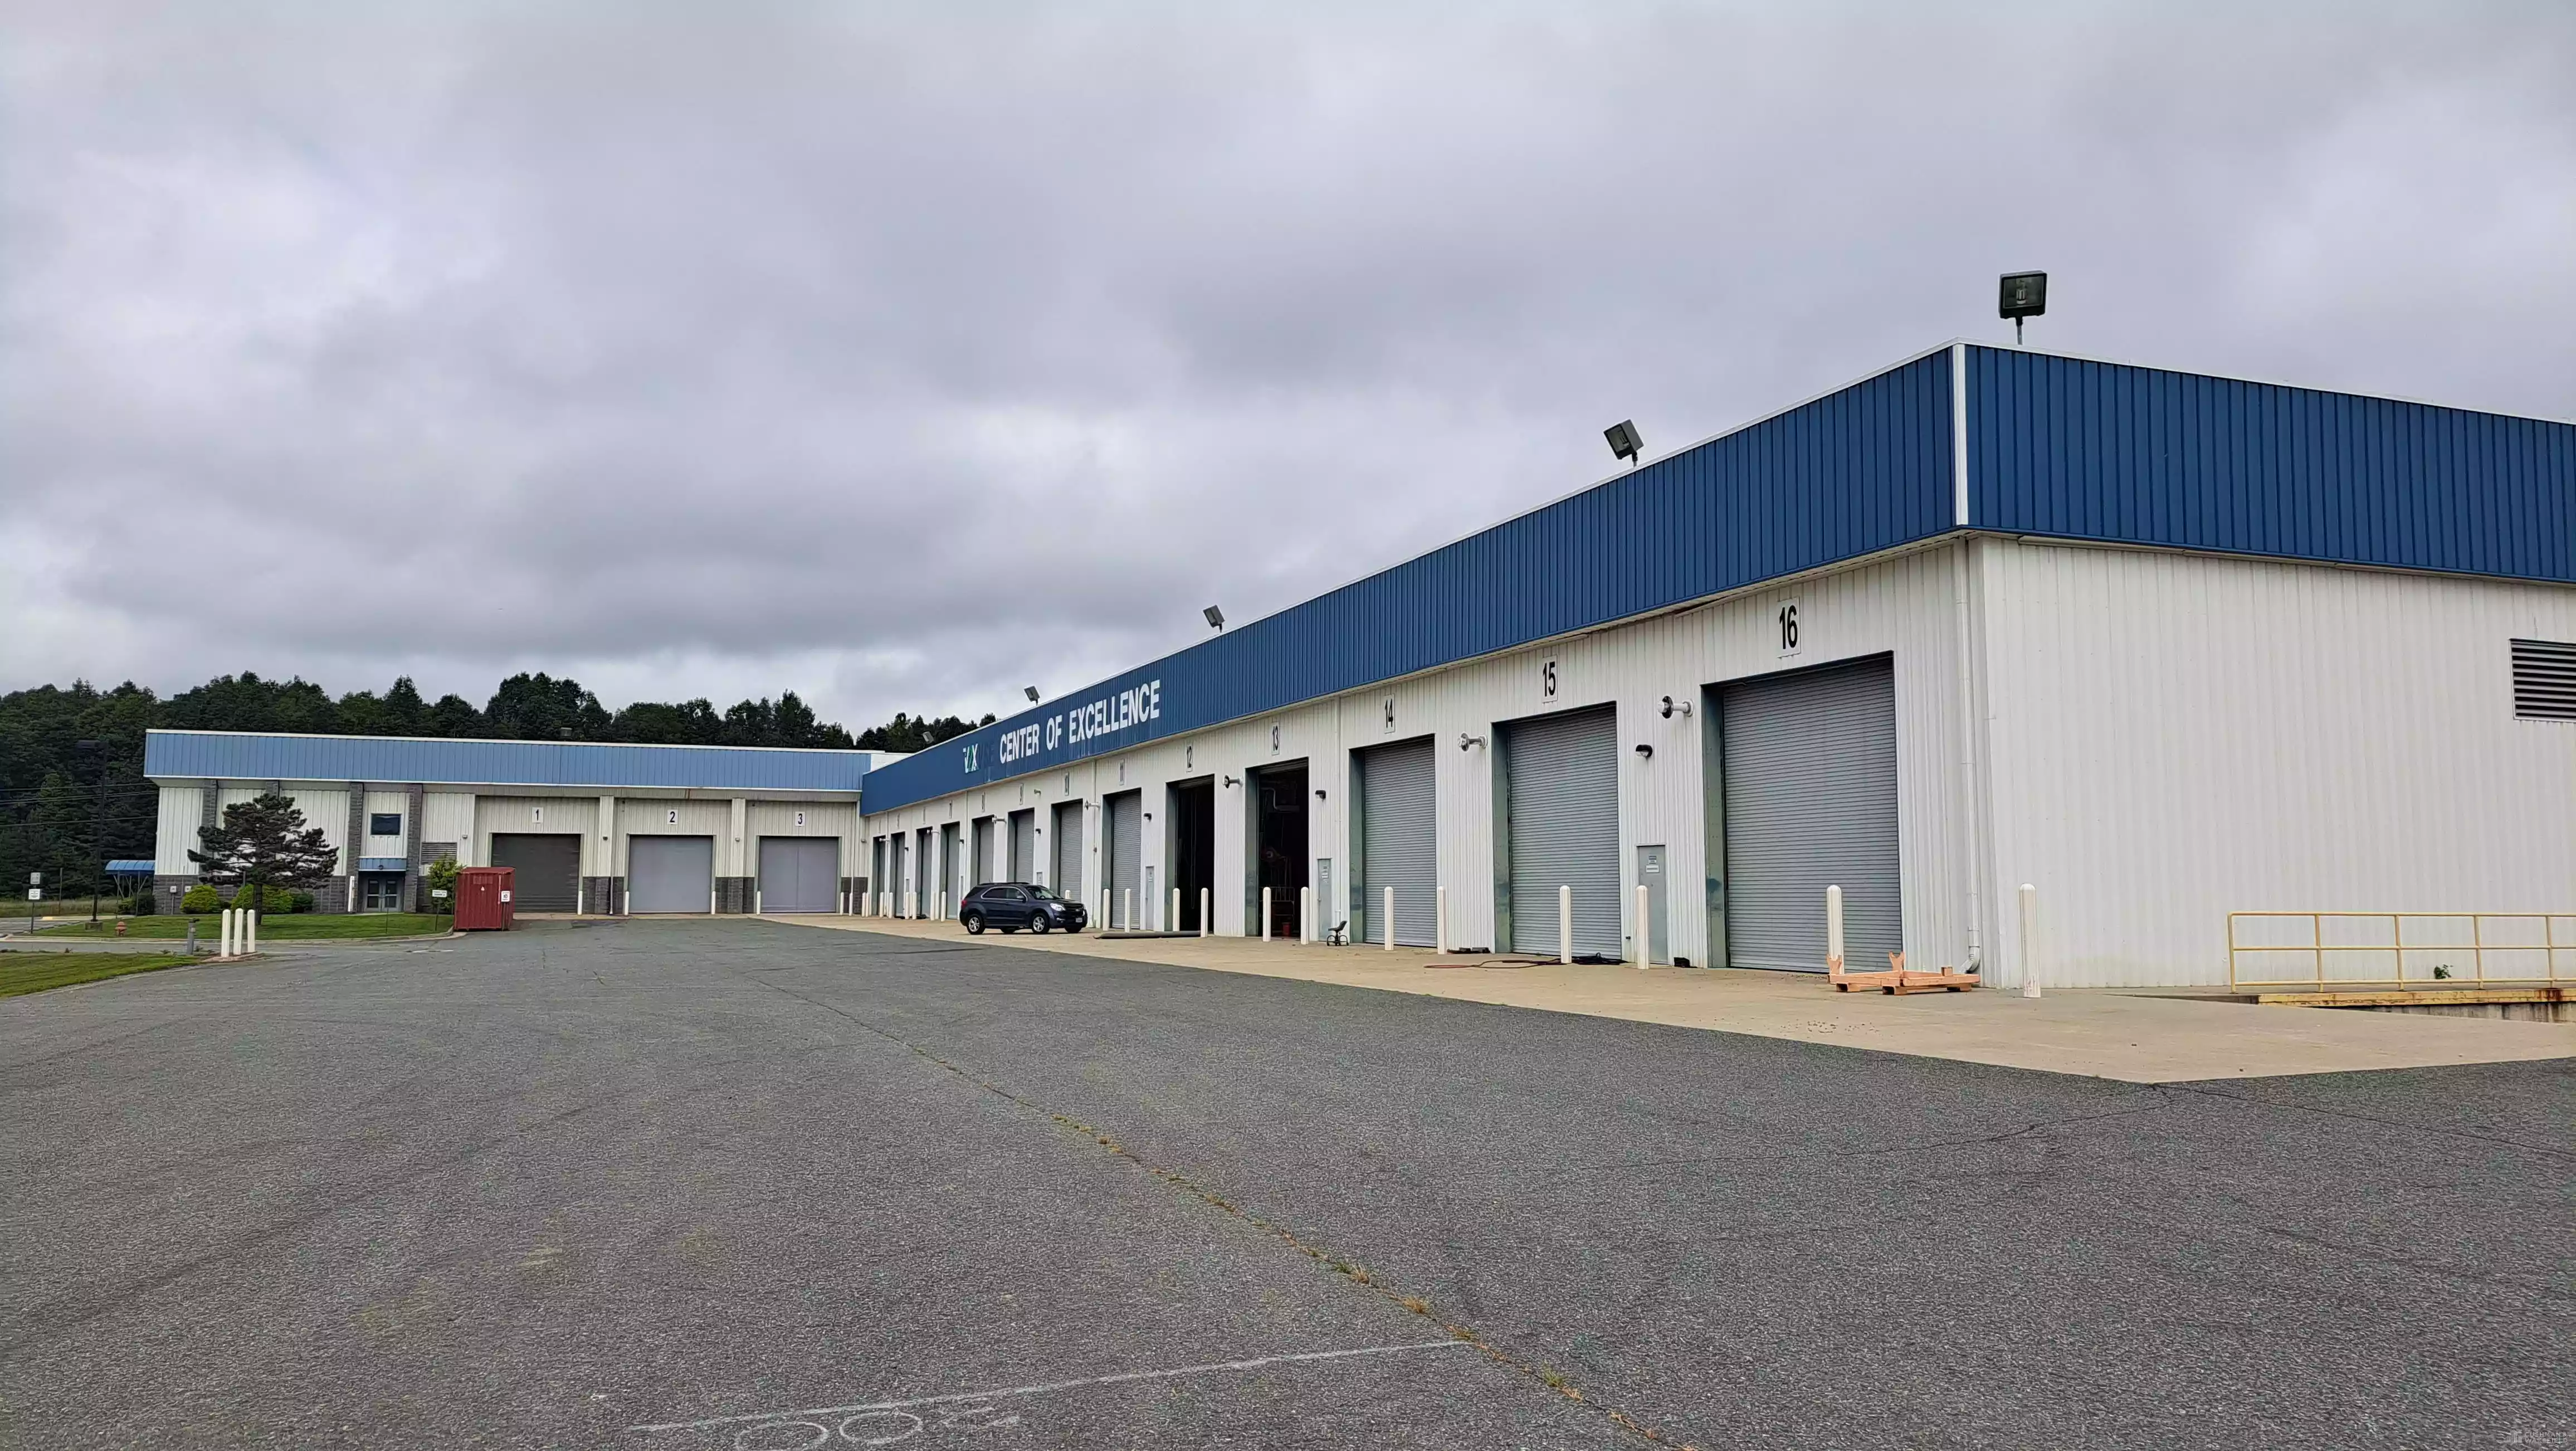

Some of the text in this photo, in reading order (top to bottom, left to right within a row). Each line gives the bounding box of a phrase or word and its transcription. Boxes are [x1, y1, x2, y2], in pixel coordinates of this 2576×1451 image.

[1779, 605, 1798, 650] 16
[1542, 661, 1556, 697] 15
[999, 723, 1040, 764] CENTER
[1046, 714, 1062, 751] OF
[1069, 679, 1160, 744] EXCELLENCE
[1384, 698, 1393, 728] 14
[1272, 726, 1279, 752] 13
[1187, 746, 1192, 768] 12
[1120, 762, 1124, 782] 11
[535, 809, 539, 821] 1
[670, 811, 676, 823] 2
[797, 813, 803, 825] 3
